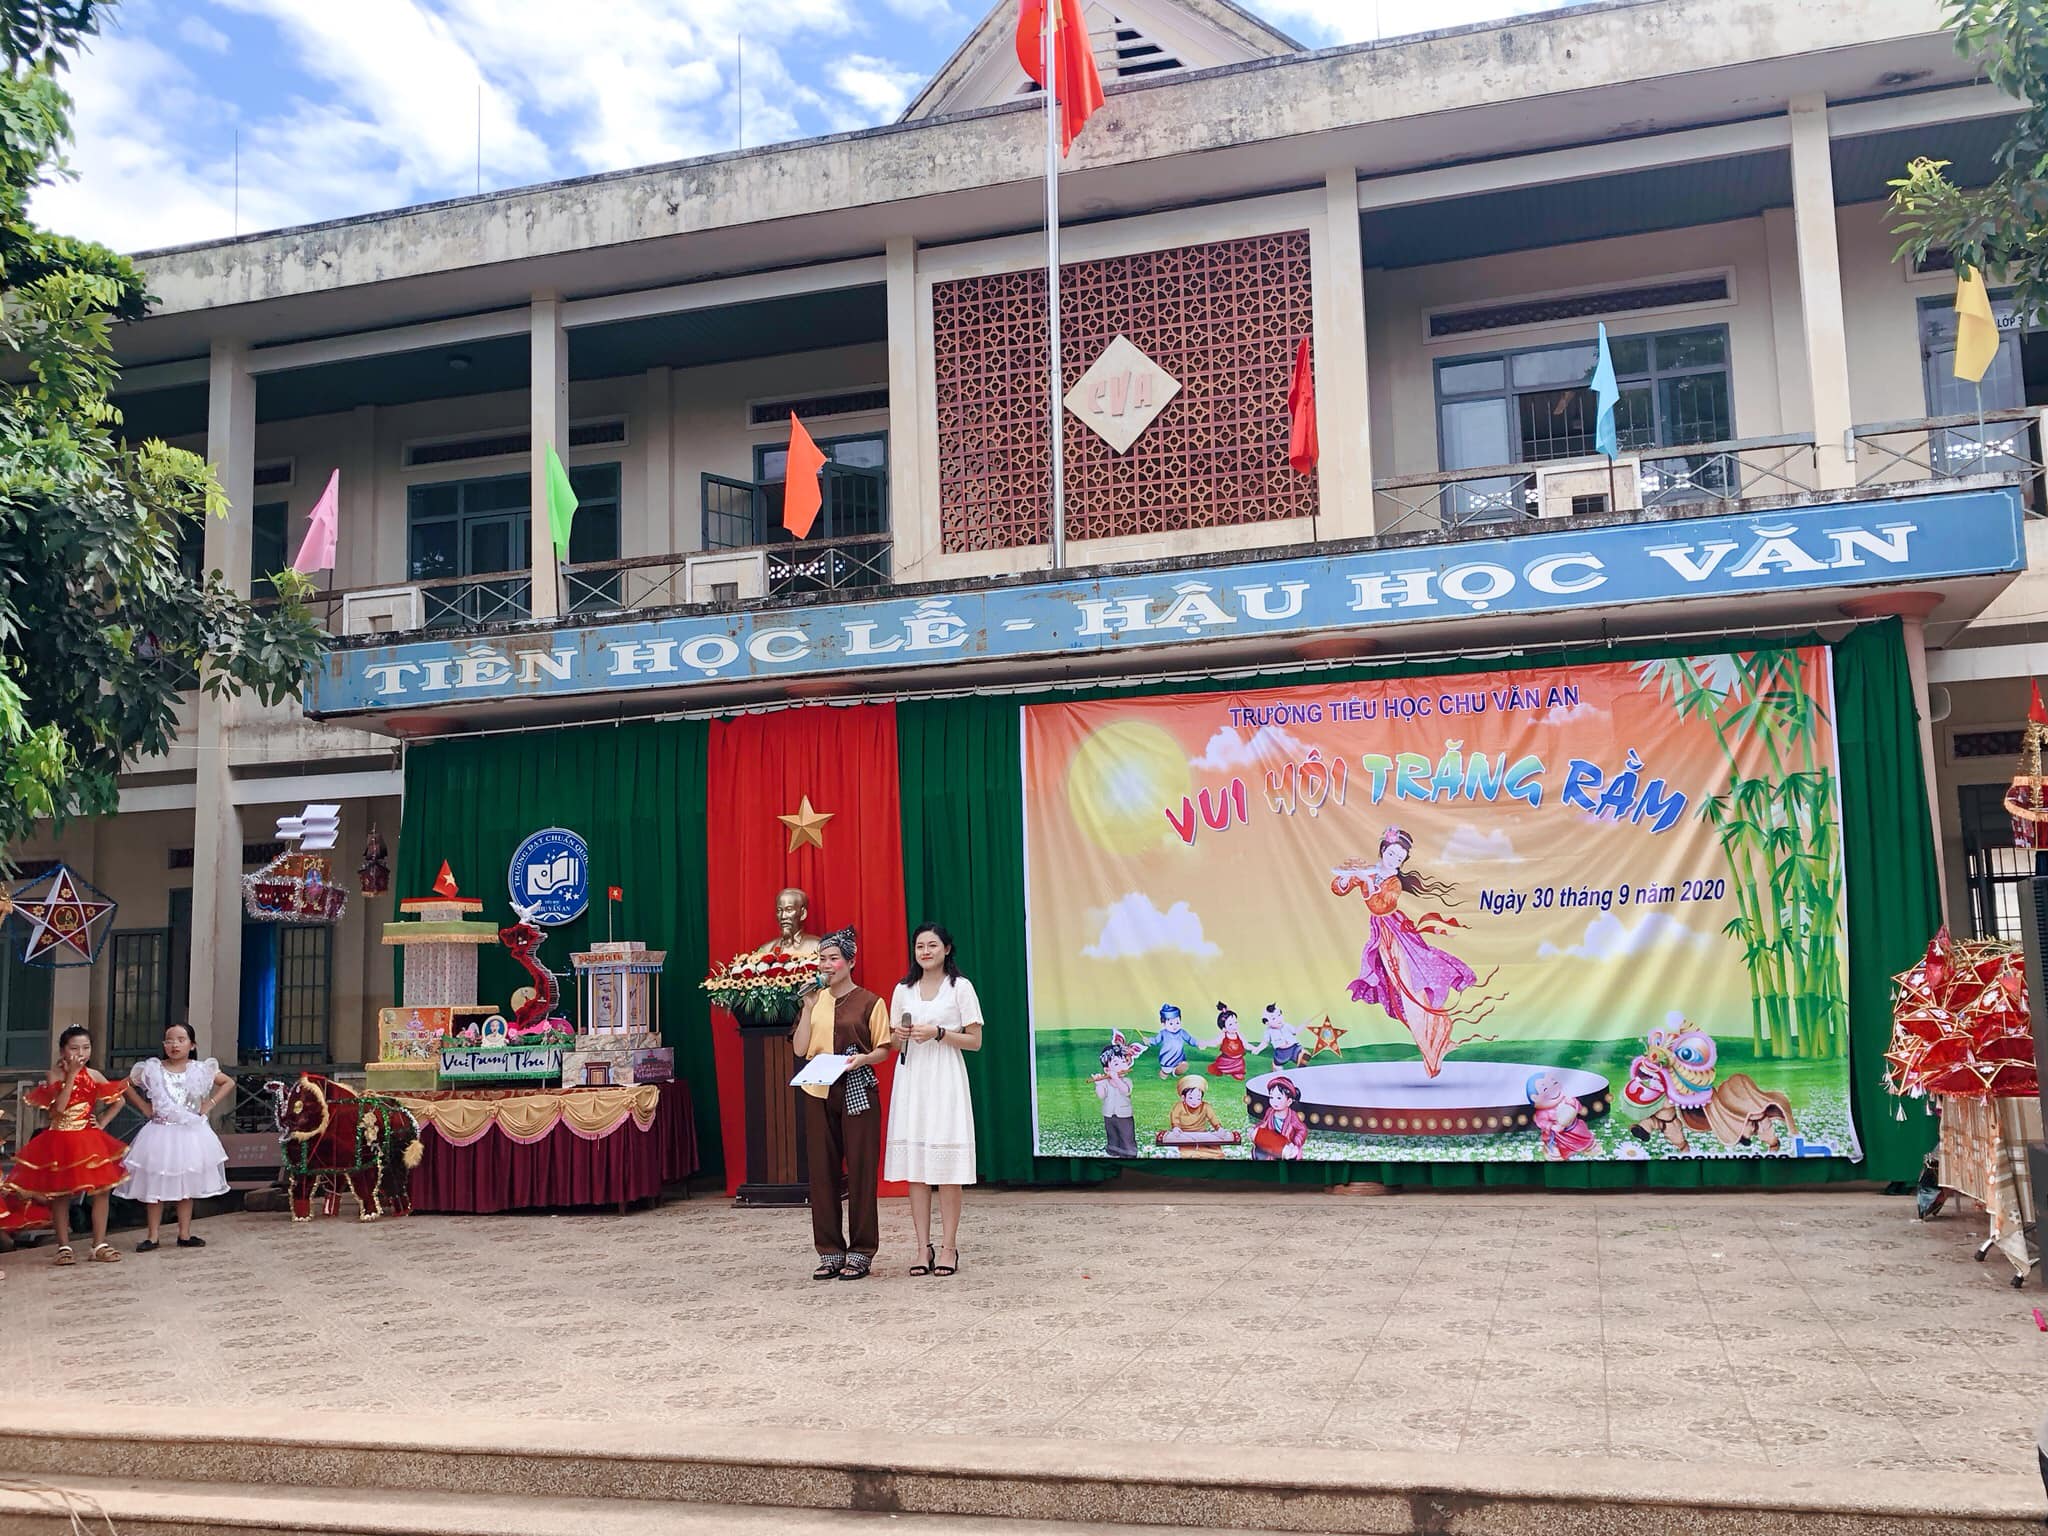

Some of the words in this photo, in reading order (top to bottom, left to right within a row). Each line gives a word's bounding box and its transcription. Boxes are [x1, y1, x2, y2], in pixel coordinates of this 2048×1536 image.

[1996, 314, 2016, 328] LỚP
[607, 626, 811, 677] HỌC
[842, 599, 970, 656] LỄ
[1073, 580, 1311, 636] HẬU
[1346, 551, 1609, 611] HỌC
[1644, 521, 1918, 582] VĂN
[1229, 701, 1323, 728] TRƯỜNG
[1328, 696, 1378, 722] TIỂU
[1384, 696, 1433, 723] HỌC
[1440, 691, 1487, 716] CHU
[1493, 685, 1541, 711] VĂN
[1546, 685, 1580, 708] AN
[1165, 778, 1250, 847] VUI
[1263, 748, 1349, 817] HỘI
[1363, 739, 1546, 808] TRĂNG
[1562, 748, 1688, 834] RẰM
[1479, 889, 1527, 915] Ngày
[1532, 887, 1554, 909] 30
[1560, 884, 1613, 911] tháng
[1619, 884, 1630, 905] 9
[1636, 881, 1675, 905] năm
[1681, 878, 1726, 902] 2020
[465, 1051, 509, 1072] Trung
[510, 1050, 545, 1071] Thu
